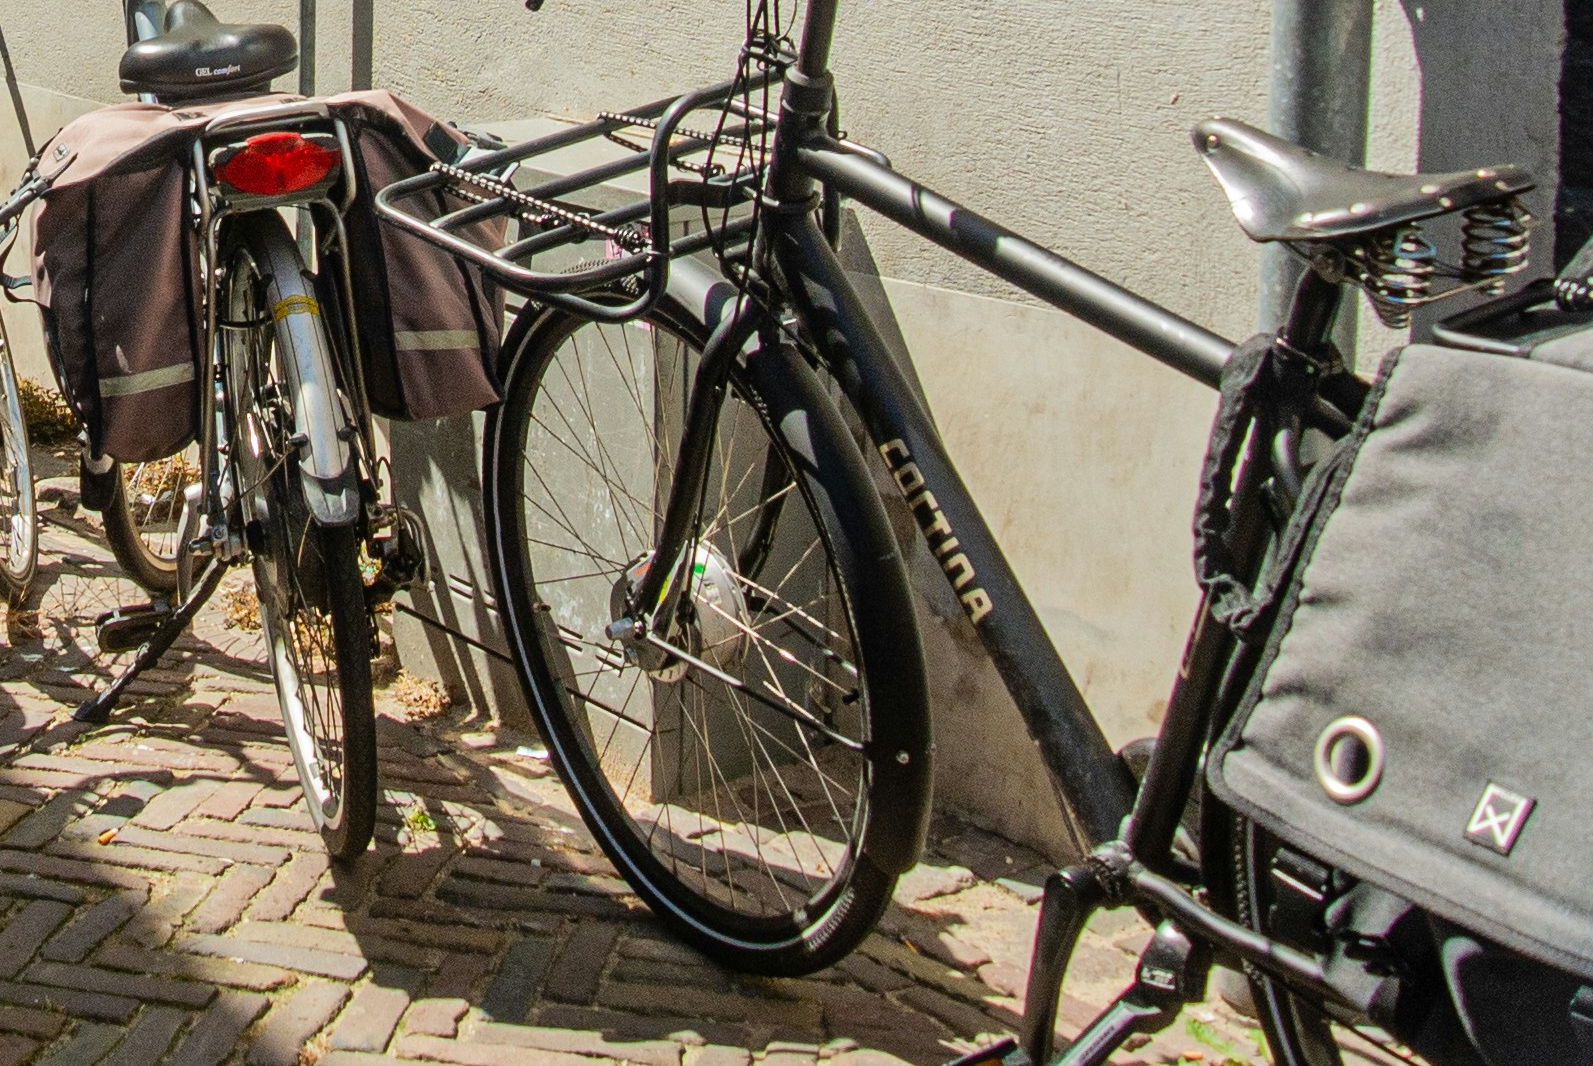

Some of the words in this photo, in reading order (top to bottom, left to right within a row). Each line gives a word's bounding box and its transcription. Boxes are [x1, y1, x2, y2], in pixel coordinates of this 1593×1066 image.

[195, 67, 212, 77] GEL
[213, 64, 241, 75] comfort
[879, 438, 993, 626] CORTINA
